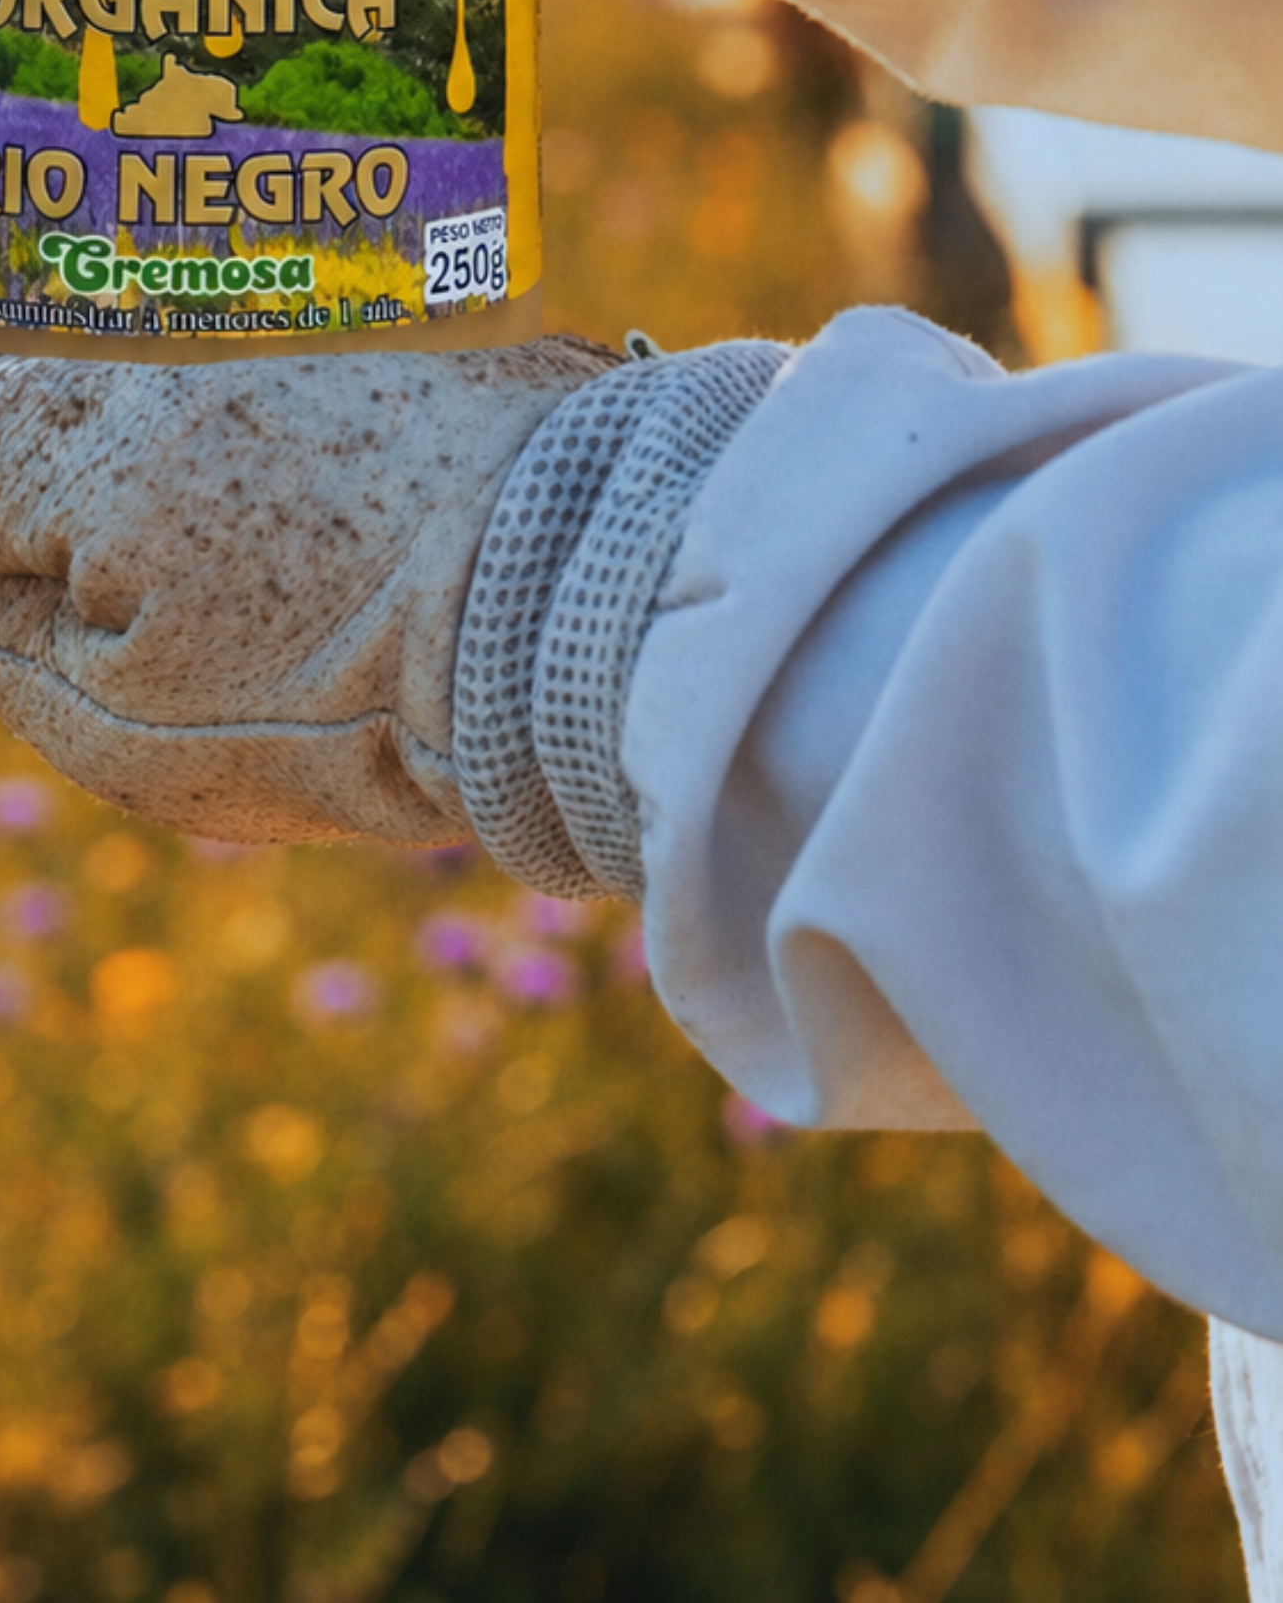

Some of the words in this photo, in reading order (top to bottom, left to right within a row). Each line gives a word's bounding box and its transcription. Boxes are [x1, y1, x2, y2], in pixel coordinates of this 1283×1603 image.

[117, 144, 410, 228] NEGRO
[430, 223, 469, 244] PESO
[430, 243, 504, 291] 250g
[170, 311, 290, 331] menores
[298, 302, 330, 326] de
